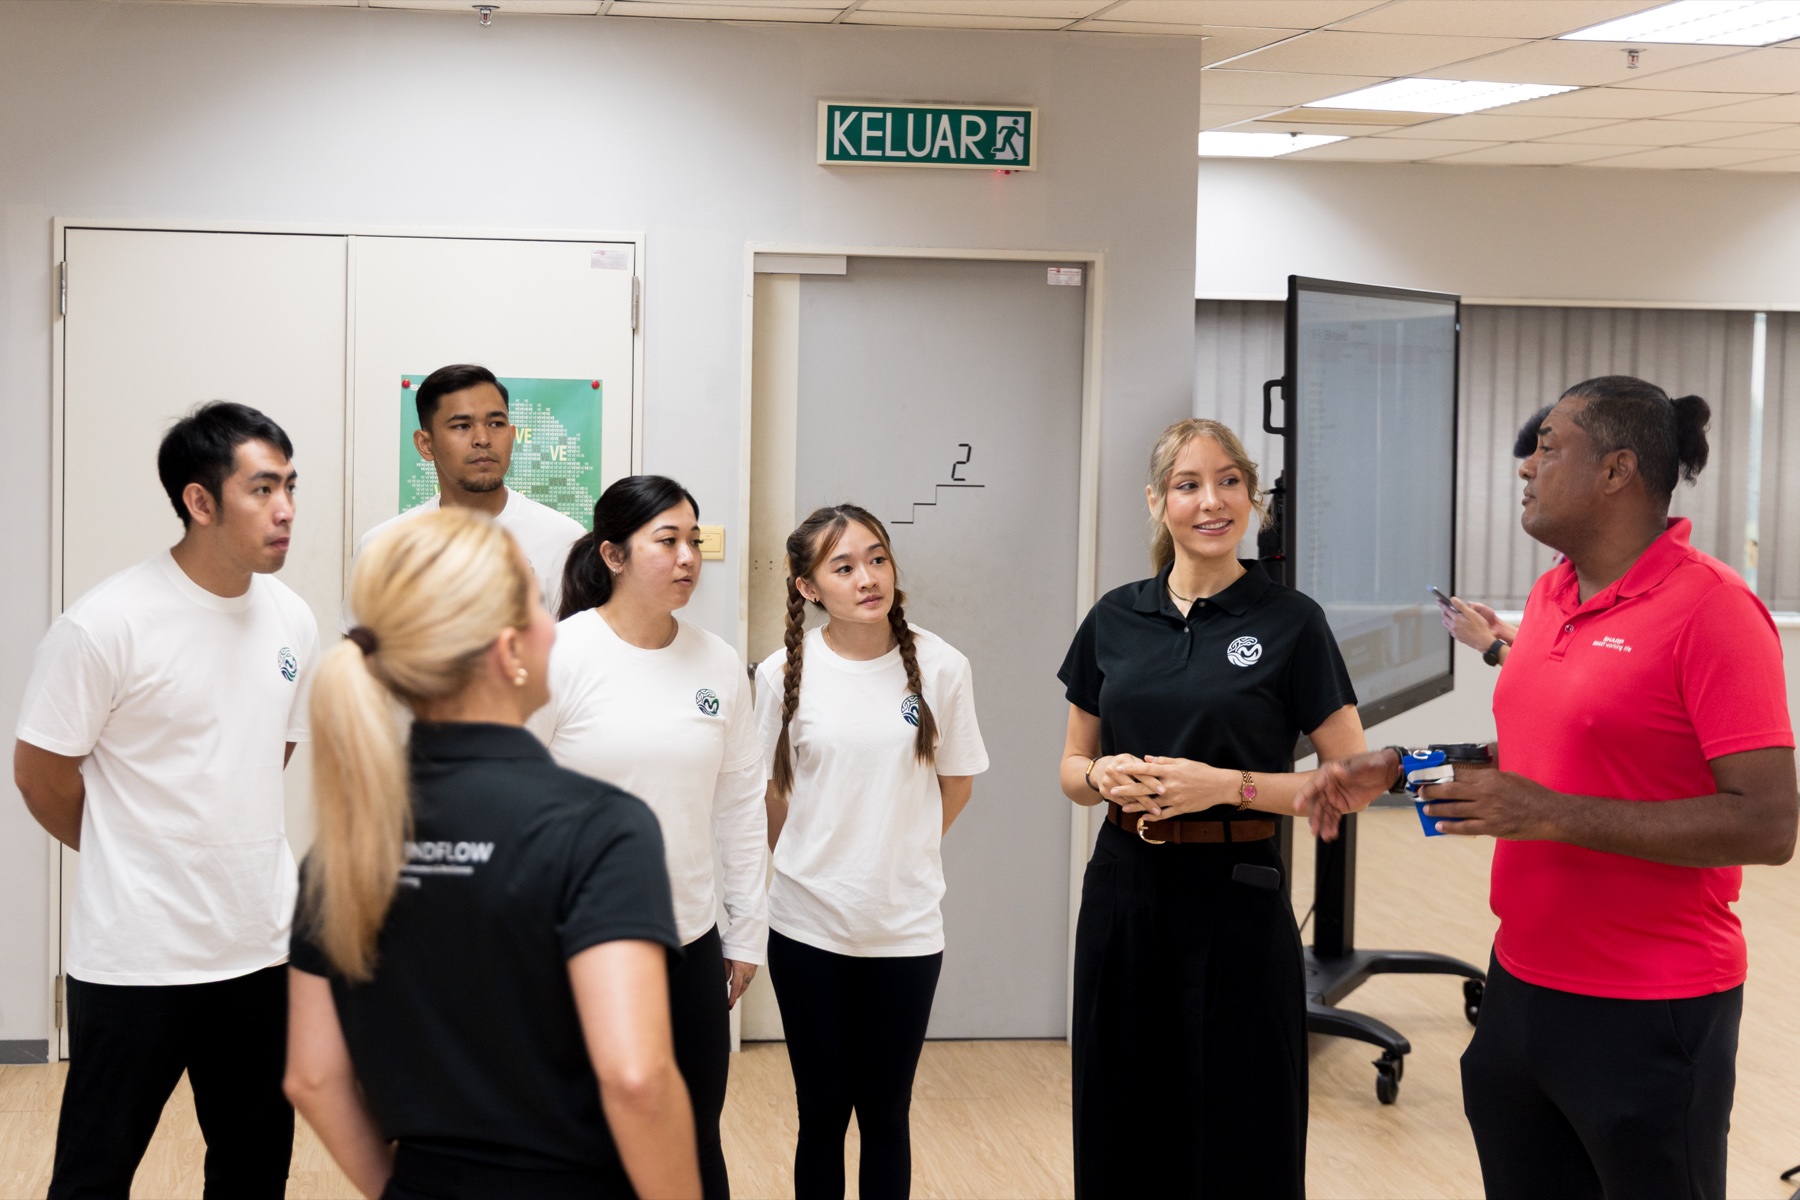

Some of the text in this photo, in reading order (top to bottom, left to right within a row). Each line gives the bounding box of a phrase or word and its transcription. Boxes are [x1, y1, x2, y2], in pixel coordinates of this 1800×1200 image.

[833, 110, 987, 160] KELUAR
[515, 428, 532, 444] VE
[550, 445, 567, 461] VE
[951, 443, 972, 481] 2
